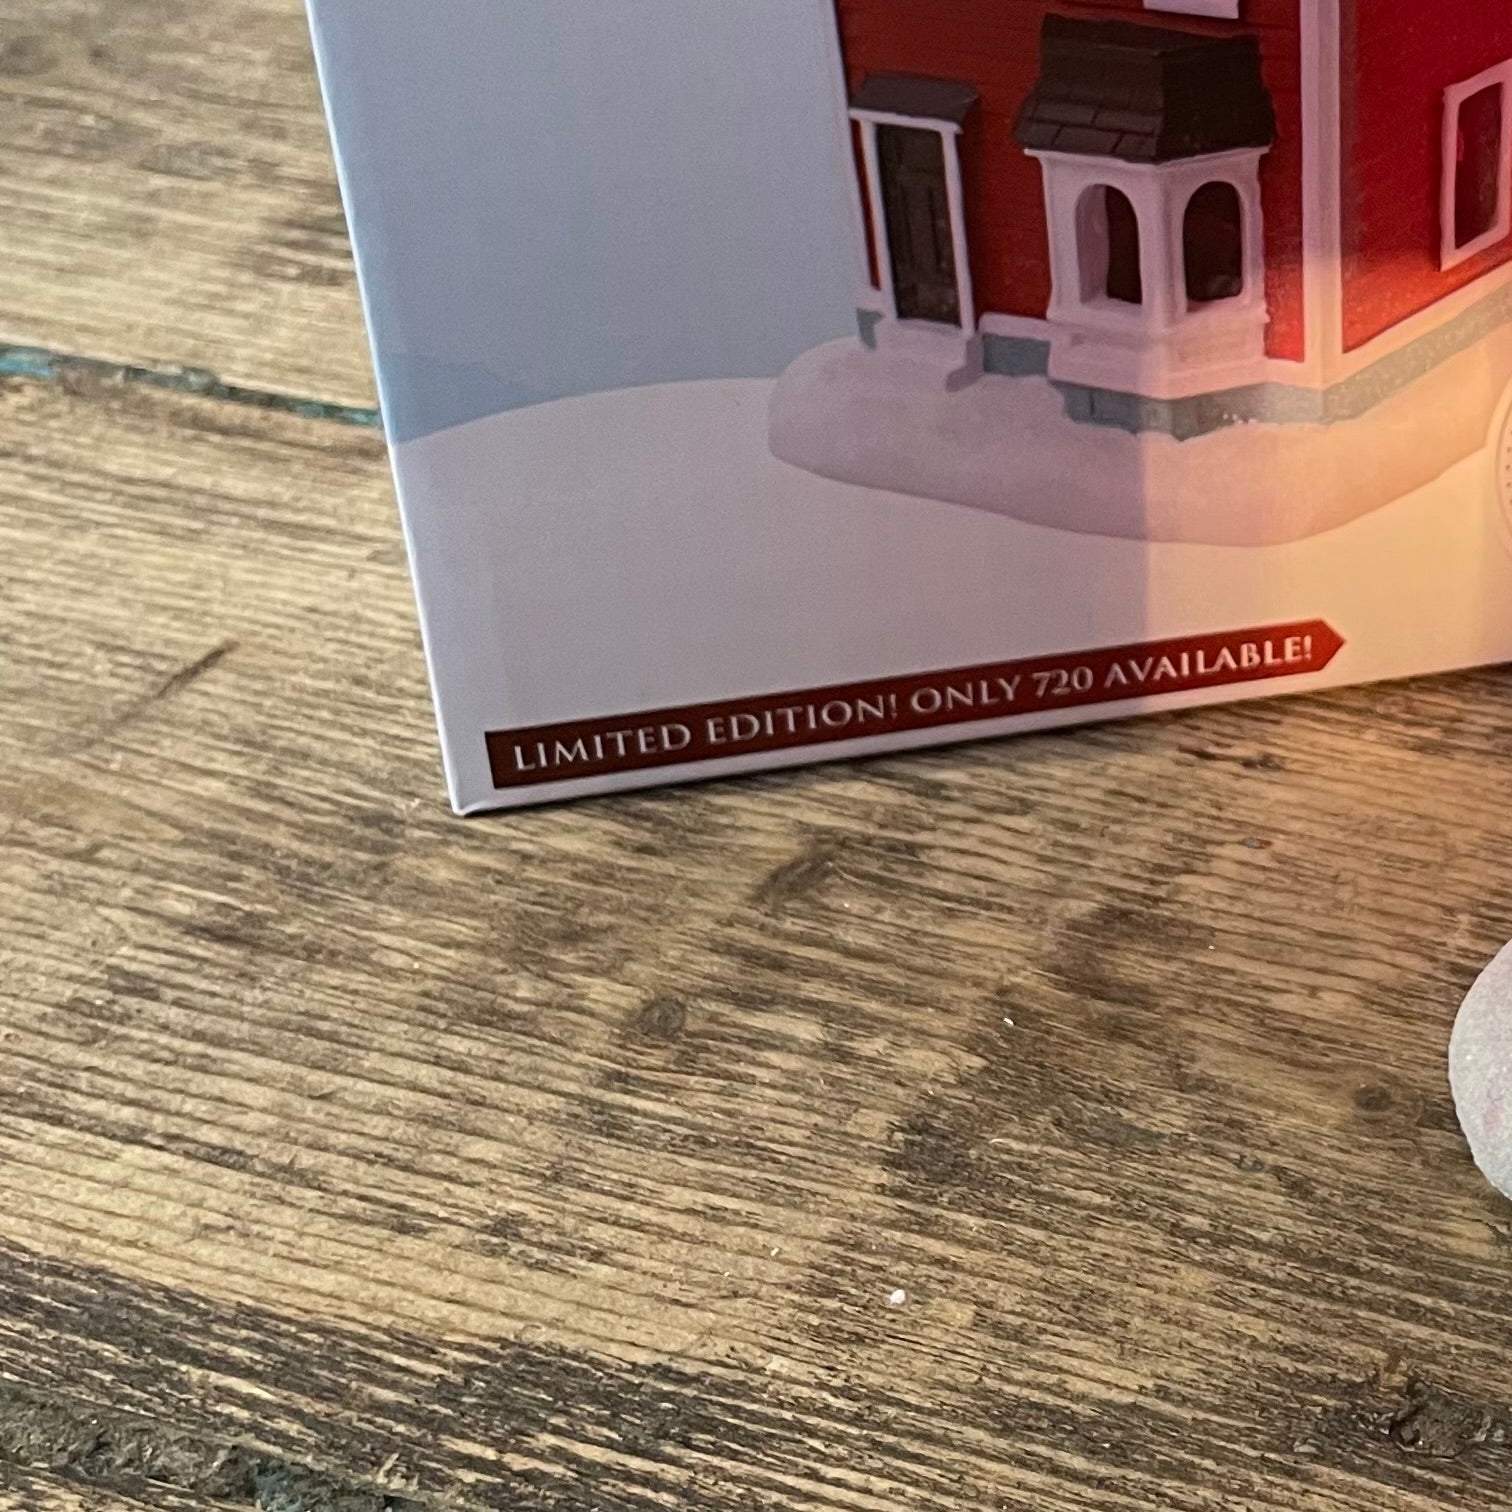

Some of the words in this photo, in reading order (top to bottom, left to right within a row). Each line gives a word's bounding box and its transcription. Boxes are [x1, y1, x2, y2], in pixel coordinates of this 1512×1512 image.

[512, 722, 692, 772] LIMITED
[706, 692, 899, 746] EDITION!
[911, 674, 1021, 715] ONLY
[1032, 665, 1094, 699] 720
[1103, 634, 1313, 689] AVAILABLE!
